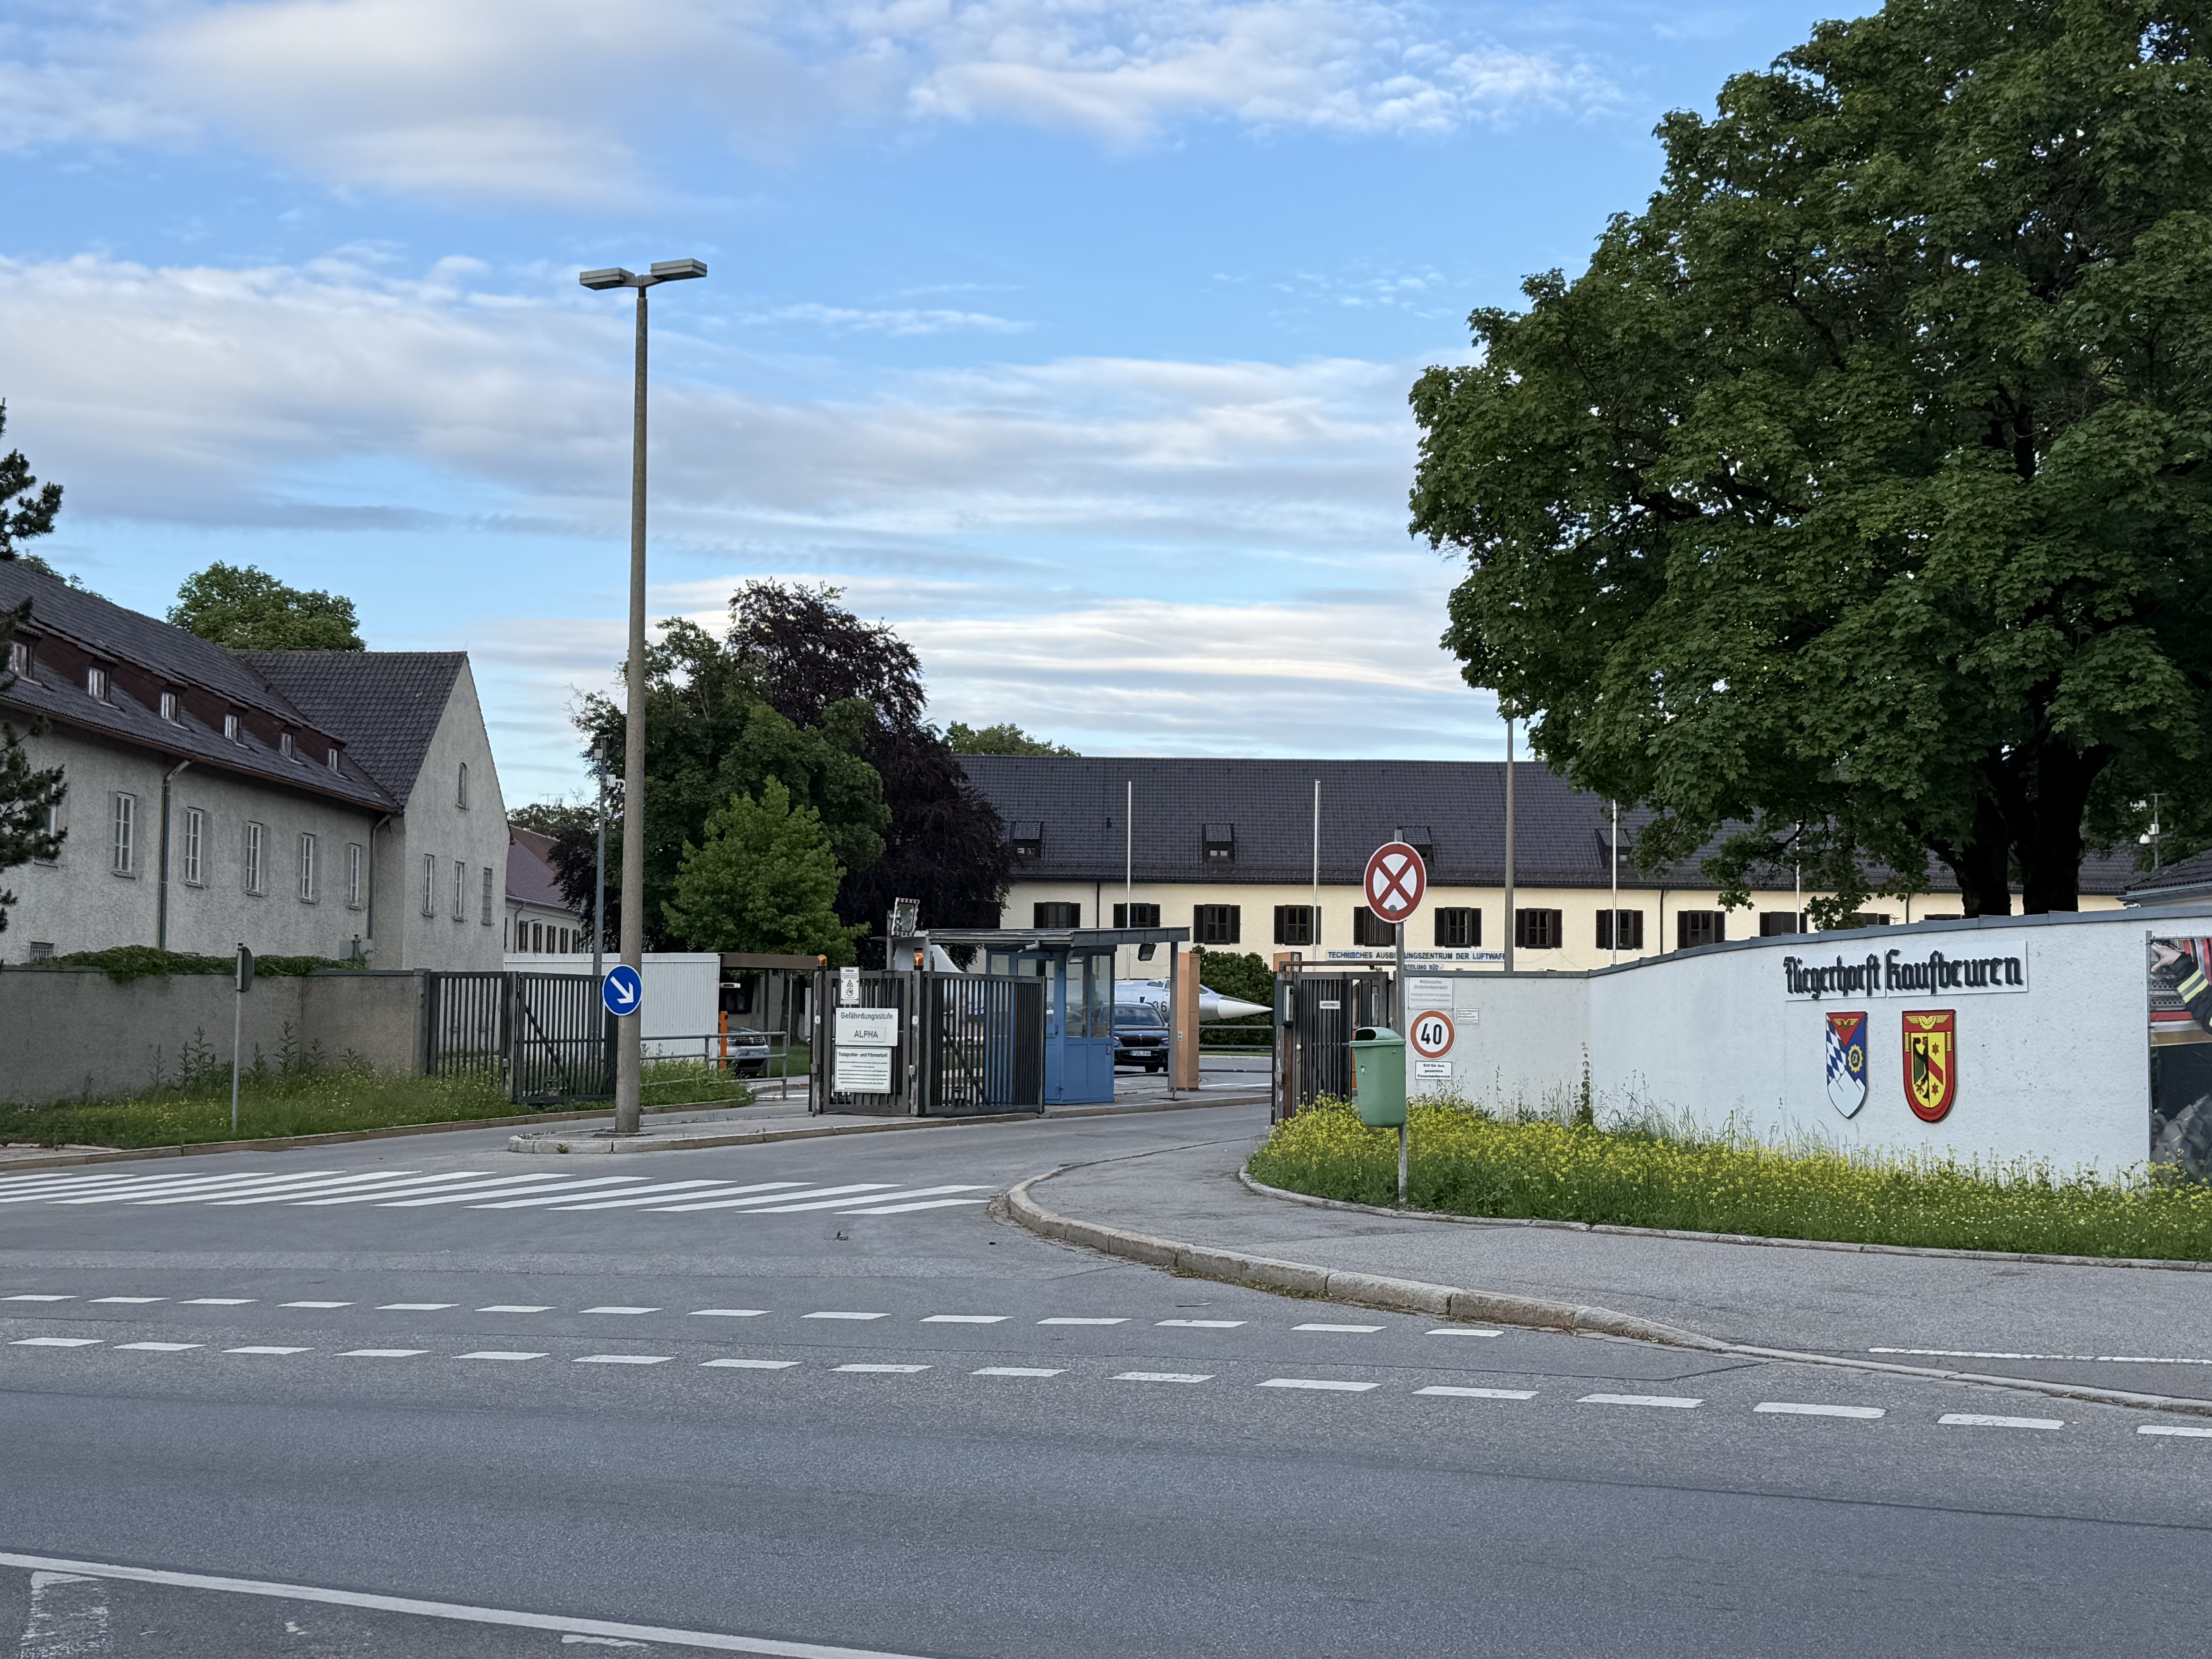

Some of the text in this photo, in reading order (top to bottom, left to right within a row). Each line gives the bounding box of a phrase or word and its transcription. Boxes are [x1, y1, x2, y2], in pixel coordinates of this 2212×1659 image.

[1886, 949, 2023, 995] Kaufbeuren
[841, 1012, 893, 1020] Gefährdungsstufe
[854, 1030, 878, 1038] ALPHA
[1421, 1023, 1442, 1044] 40
